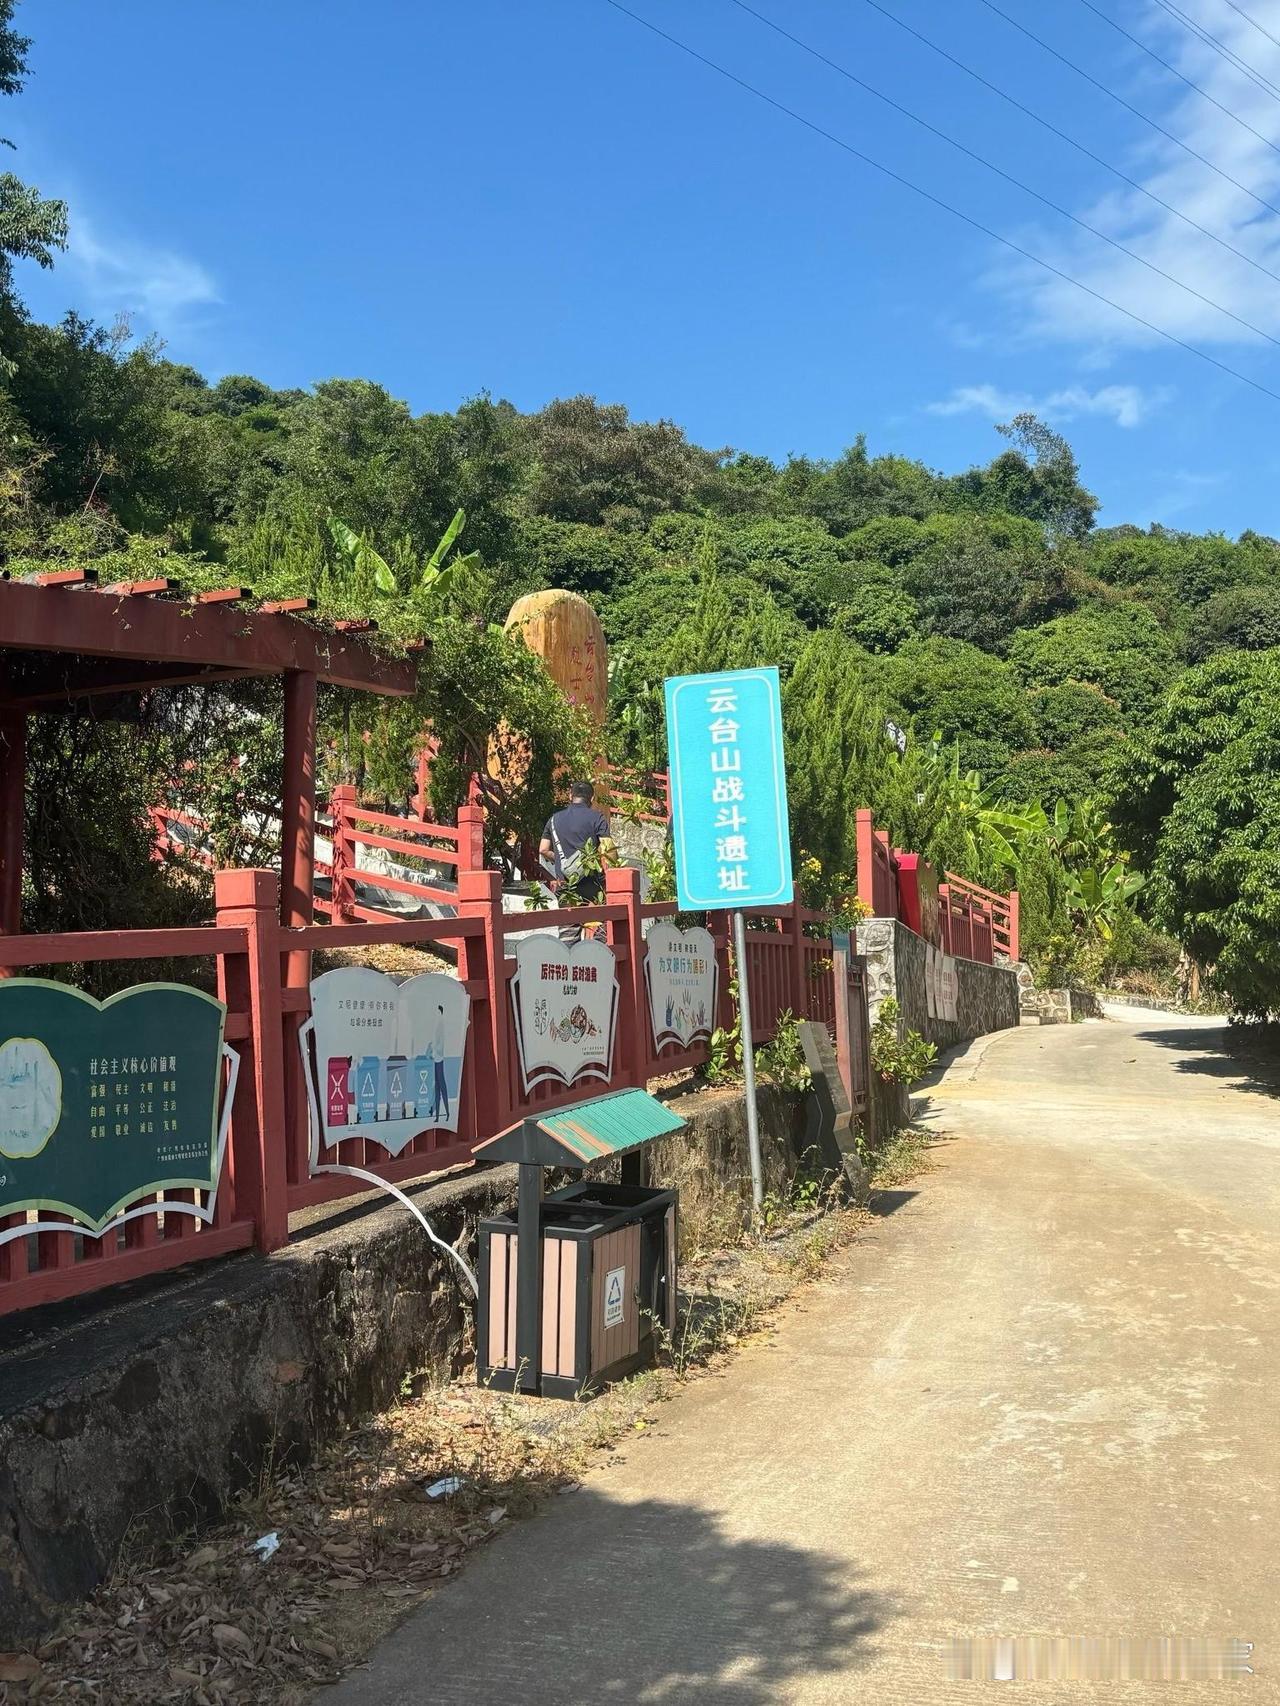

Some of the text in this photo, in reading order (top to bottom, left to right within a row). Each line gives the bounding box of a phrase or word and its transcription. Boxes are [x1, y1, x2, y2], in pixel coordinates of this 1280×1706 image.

[706, 687, 750, 891] 云台山战斗遗址
[540, 963, 569, 981] 厉行节约
[90, 1056, 176, 1075] 社会主义核心价值观
[91, 1080, 176, 1098] 富强 民主 文明 和谐
[91, 1100, 177, 1117] 自由 平等 公正 法治
[91, 1120, 177, 1138] 爱国 敬业 诚信 友善
